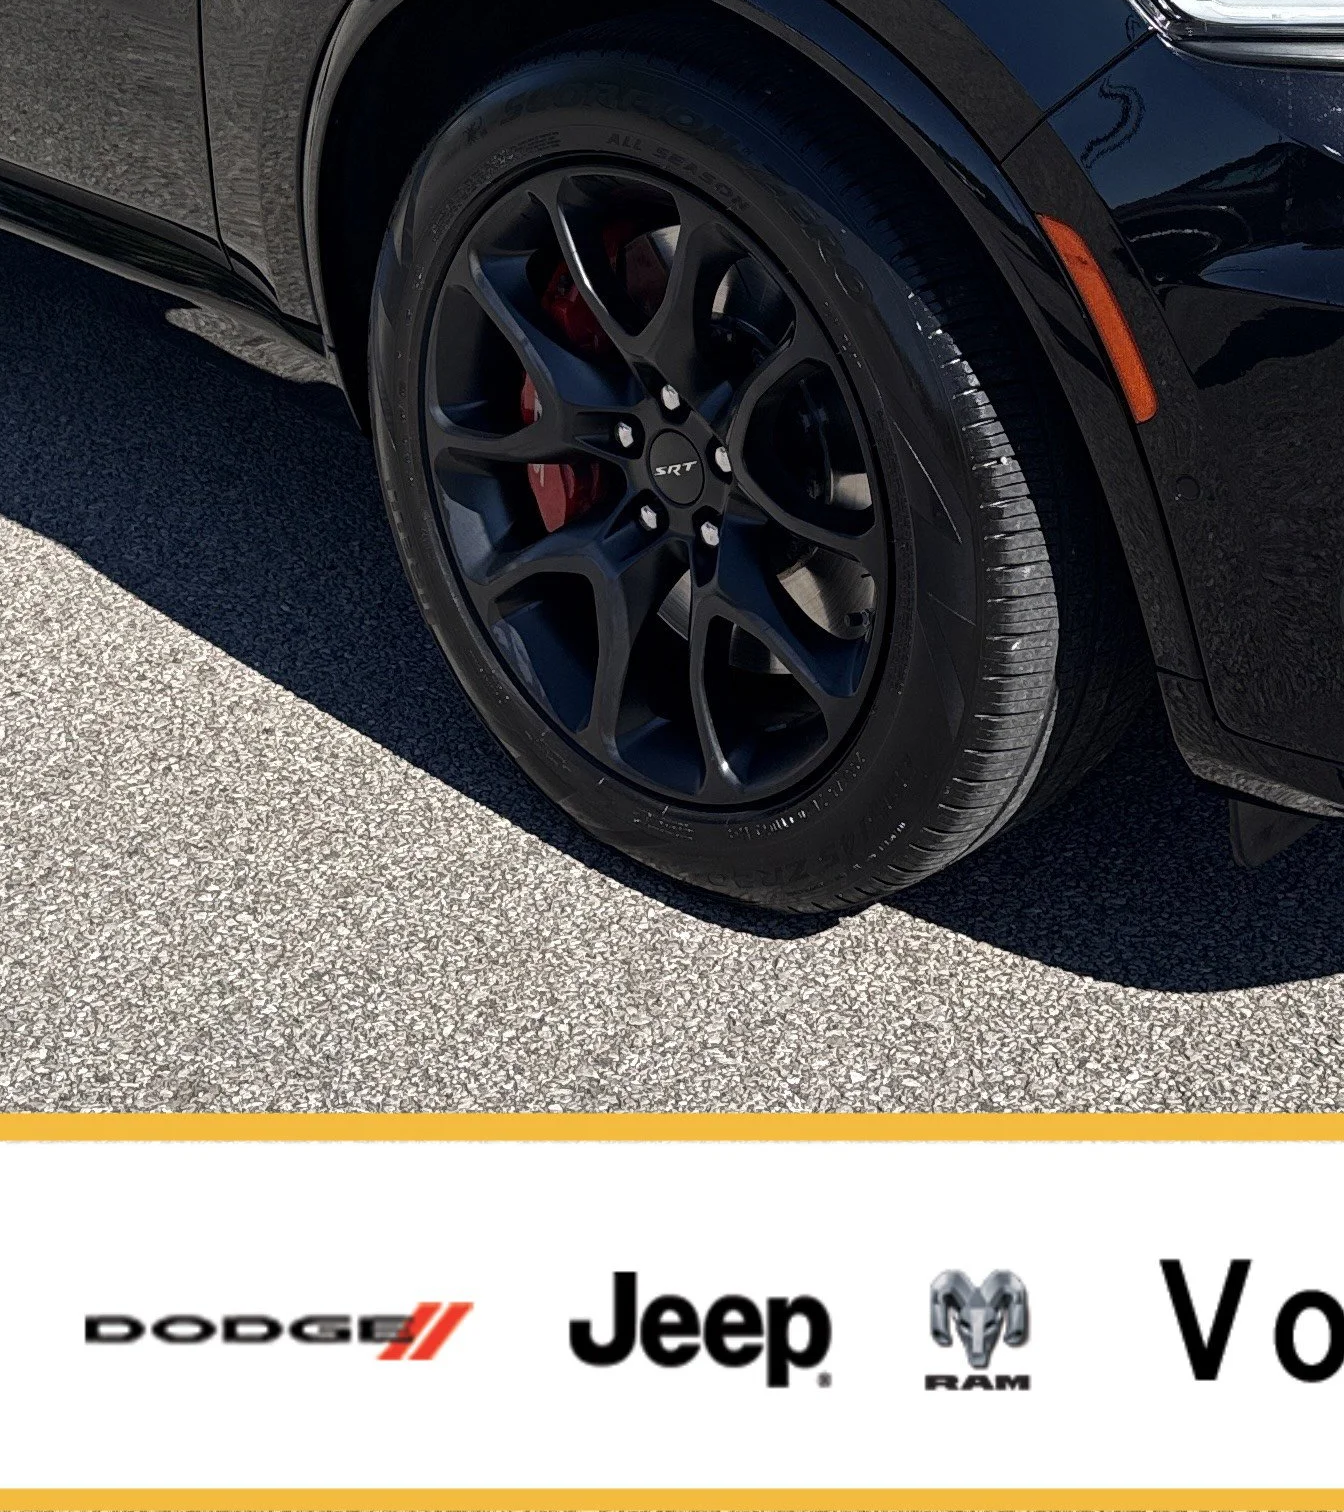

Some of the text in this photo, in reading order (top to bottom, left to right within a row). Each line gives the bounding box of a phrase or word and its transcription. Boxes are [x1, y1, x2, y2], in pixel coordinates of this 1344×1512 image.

[606, 131, 753, 214] ALL SEASON
[654, 460, 698, 476] SRT
